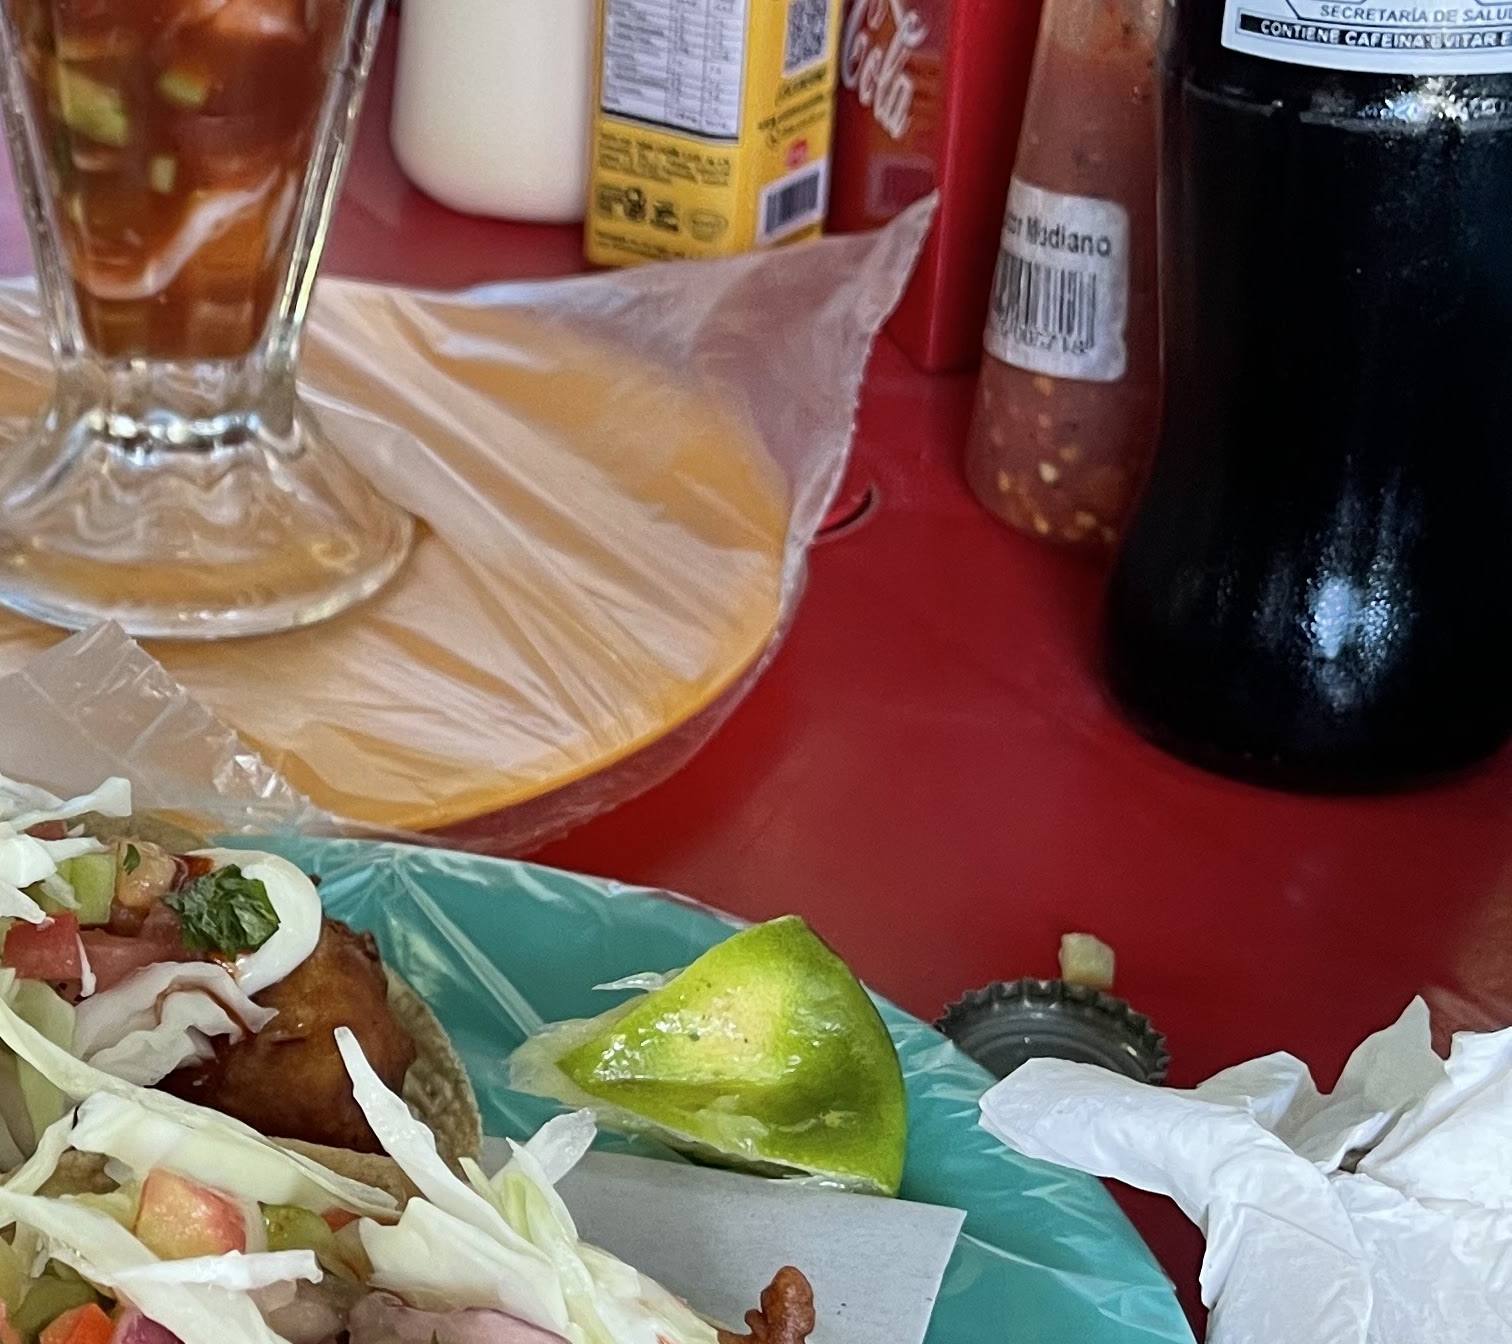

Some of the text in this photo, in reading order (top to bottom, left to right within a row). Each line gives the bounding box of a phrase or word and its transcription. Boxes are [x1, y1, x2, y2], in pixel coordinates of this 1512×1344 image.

[1320, 5, 1427, 23] SECRETARÍA
[1433, 9, 1457, 23] DE
[1261, 20, 1339, 44] CONTIENE
